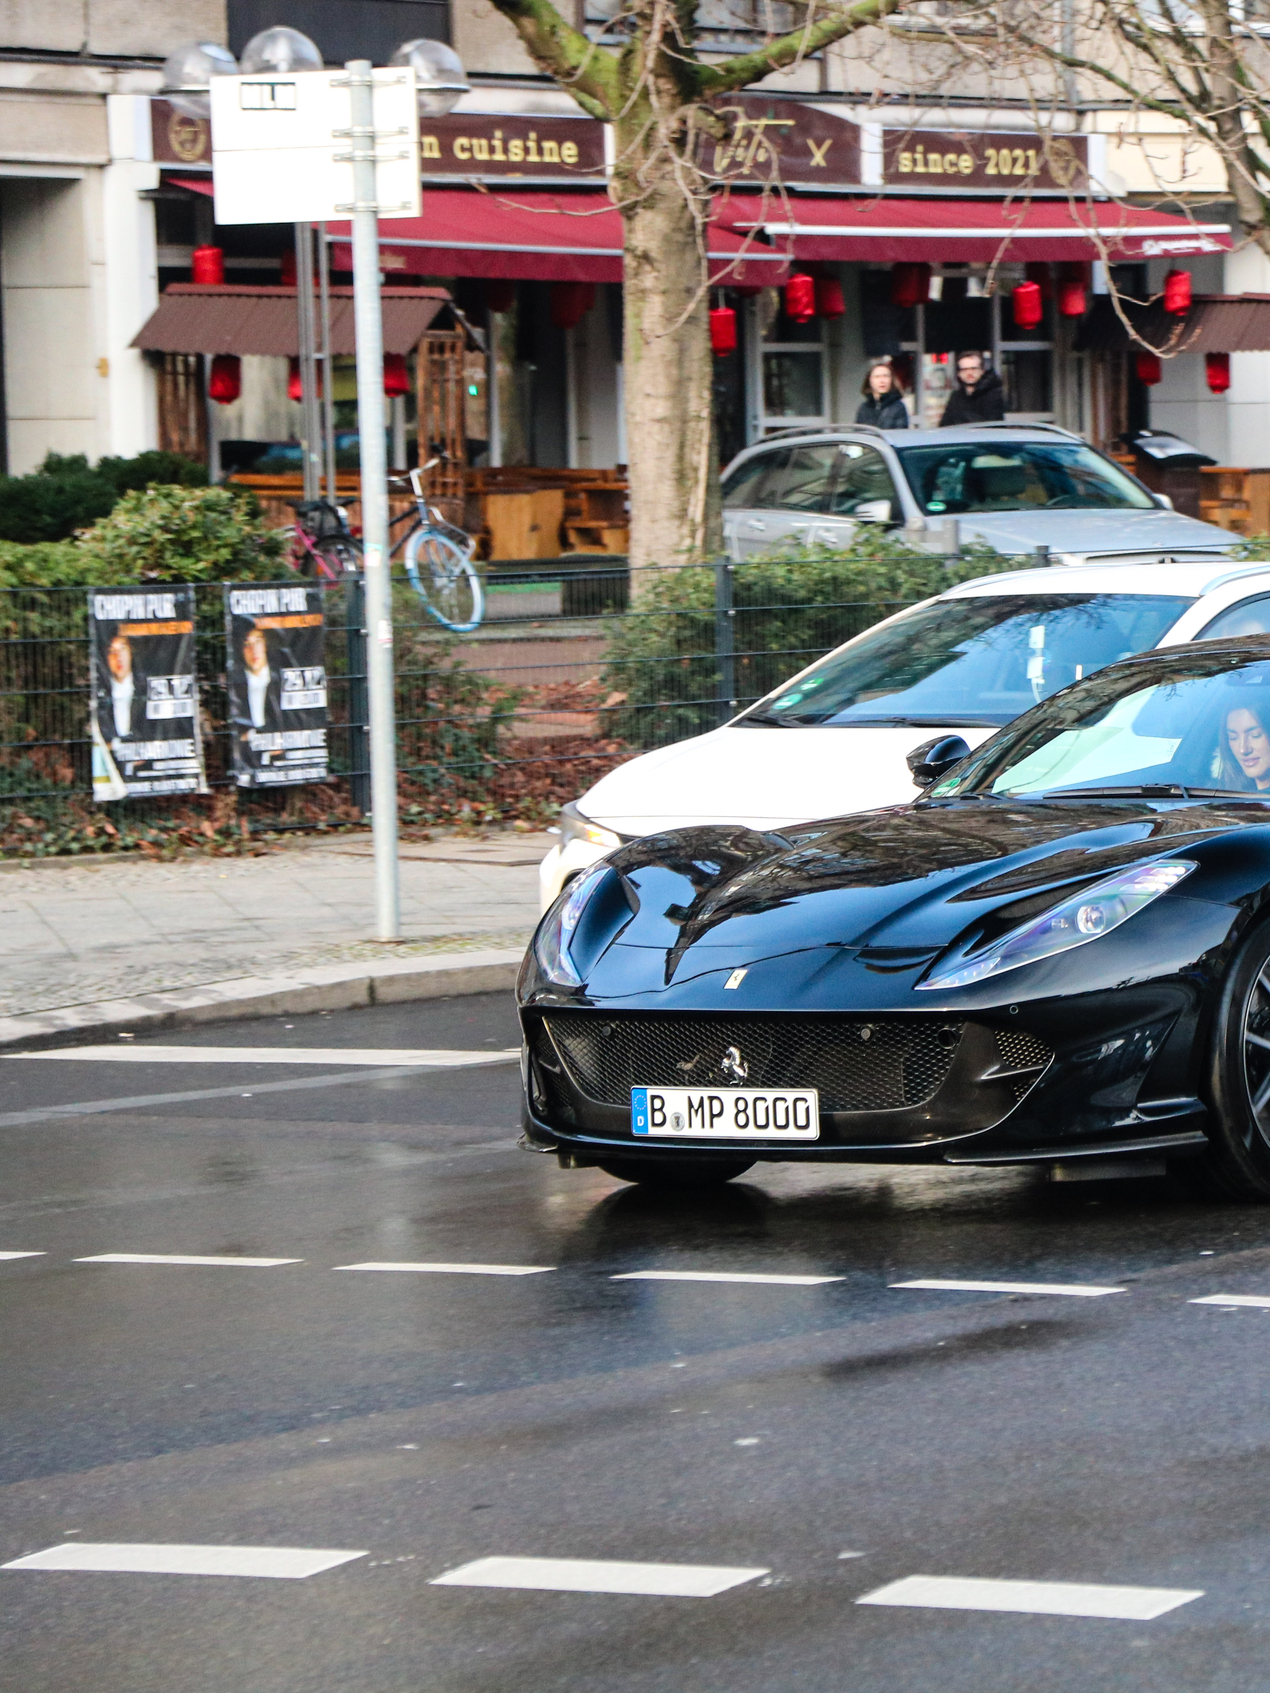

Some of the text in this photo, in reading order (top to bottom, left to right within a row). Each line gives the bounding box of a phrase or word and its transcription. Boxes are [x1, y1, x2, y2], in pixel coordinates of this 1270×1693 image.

[453, 129, 579, 164] cuisine
[898, 144, 1041, 176] since 2021
[637, 1094, 811, 1130] D B MP 8000
